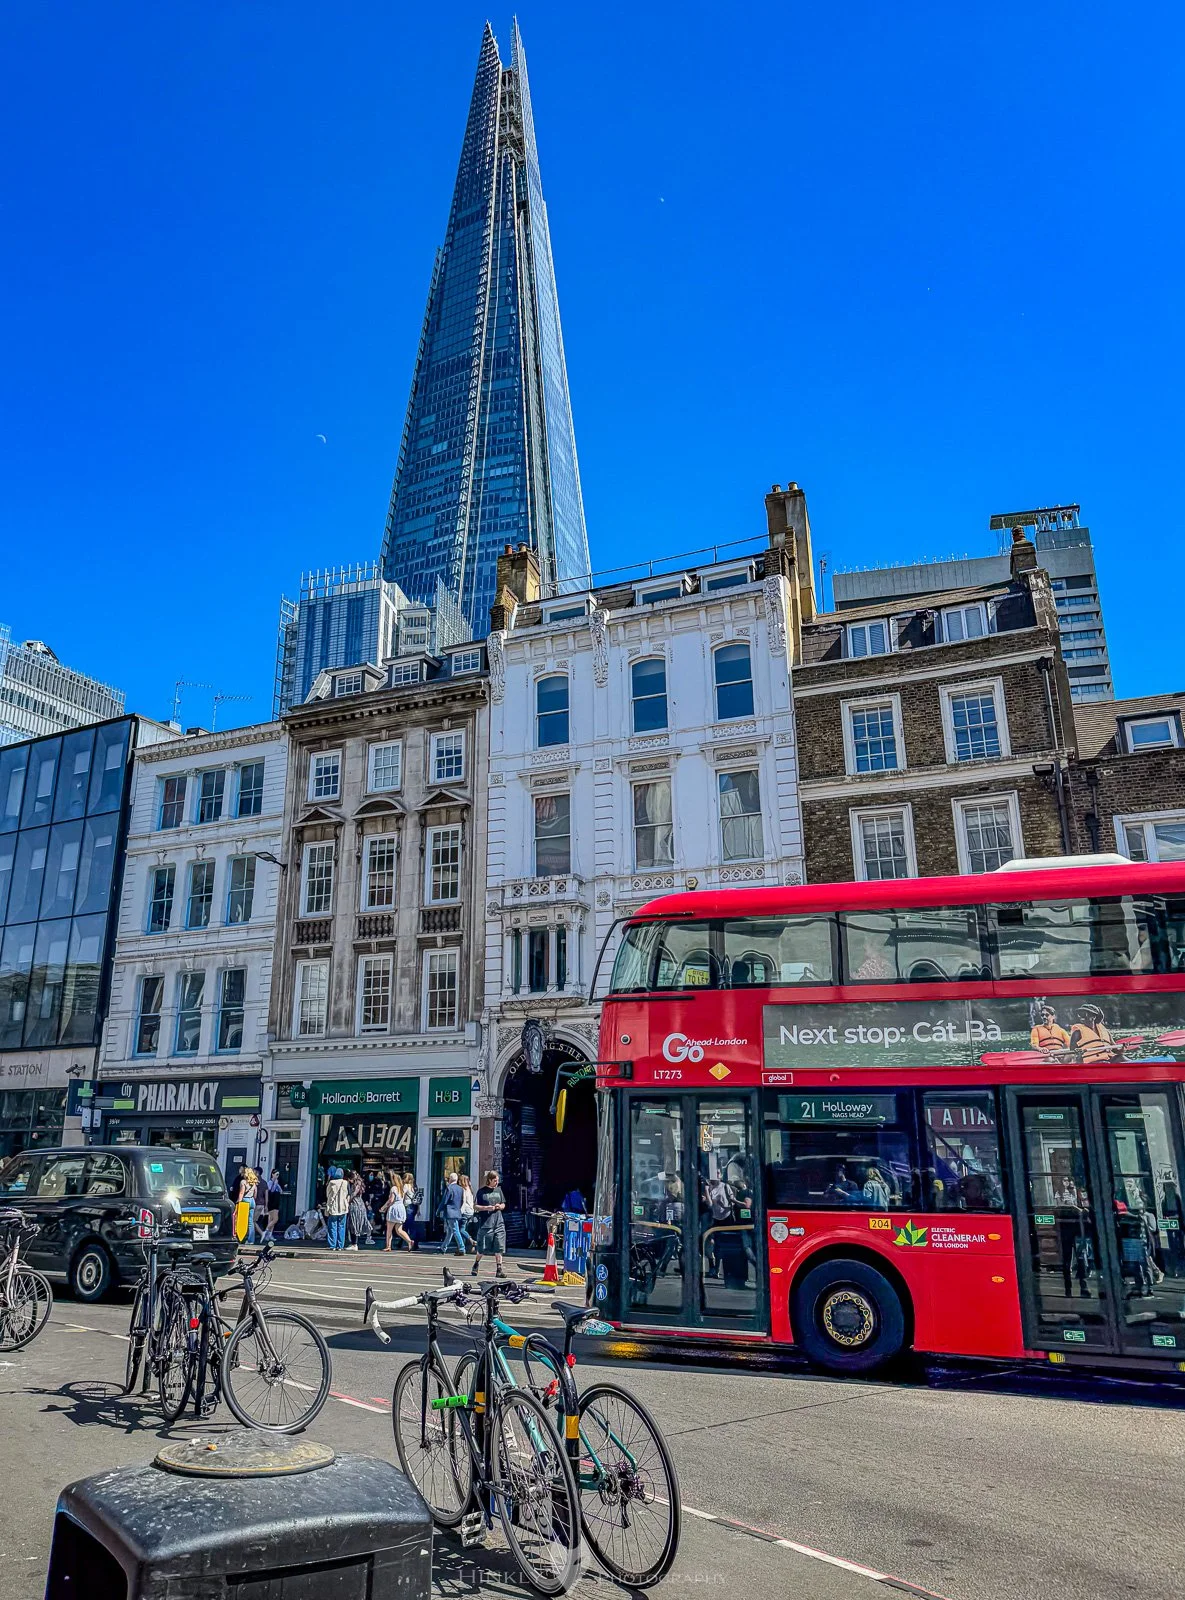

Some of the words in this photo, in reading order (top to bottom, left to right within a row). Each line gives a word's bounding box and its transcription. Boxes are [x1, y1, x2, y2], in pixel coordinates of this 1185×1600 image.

[780, 1025, 838, 1045] Next
[844, 1025, 906, 1048] stop:
[912, 1019, 957, 1043] Cát
[965, 1018, 1002, 1041] Bà
[662, 1032, 705, 1063] Go
[685, 1037, 748, 1047] Ahead-London
[8, 1063, 42, 1076] STATION
[654, 1070, 683, 1080] LT273
[768, 1074, 787, 1083] global
[121, 1082, 133, 1097] City
[137, 1082, 219, 1111] PHARMACY
[801, 1102, 816, 1118] 21
[822, 1101, 873, 1114] Holloway
[872, 1220, 889, 1229] 204
